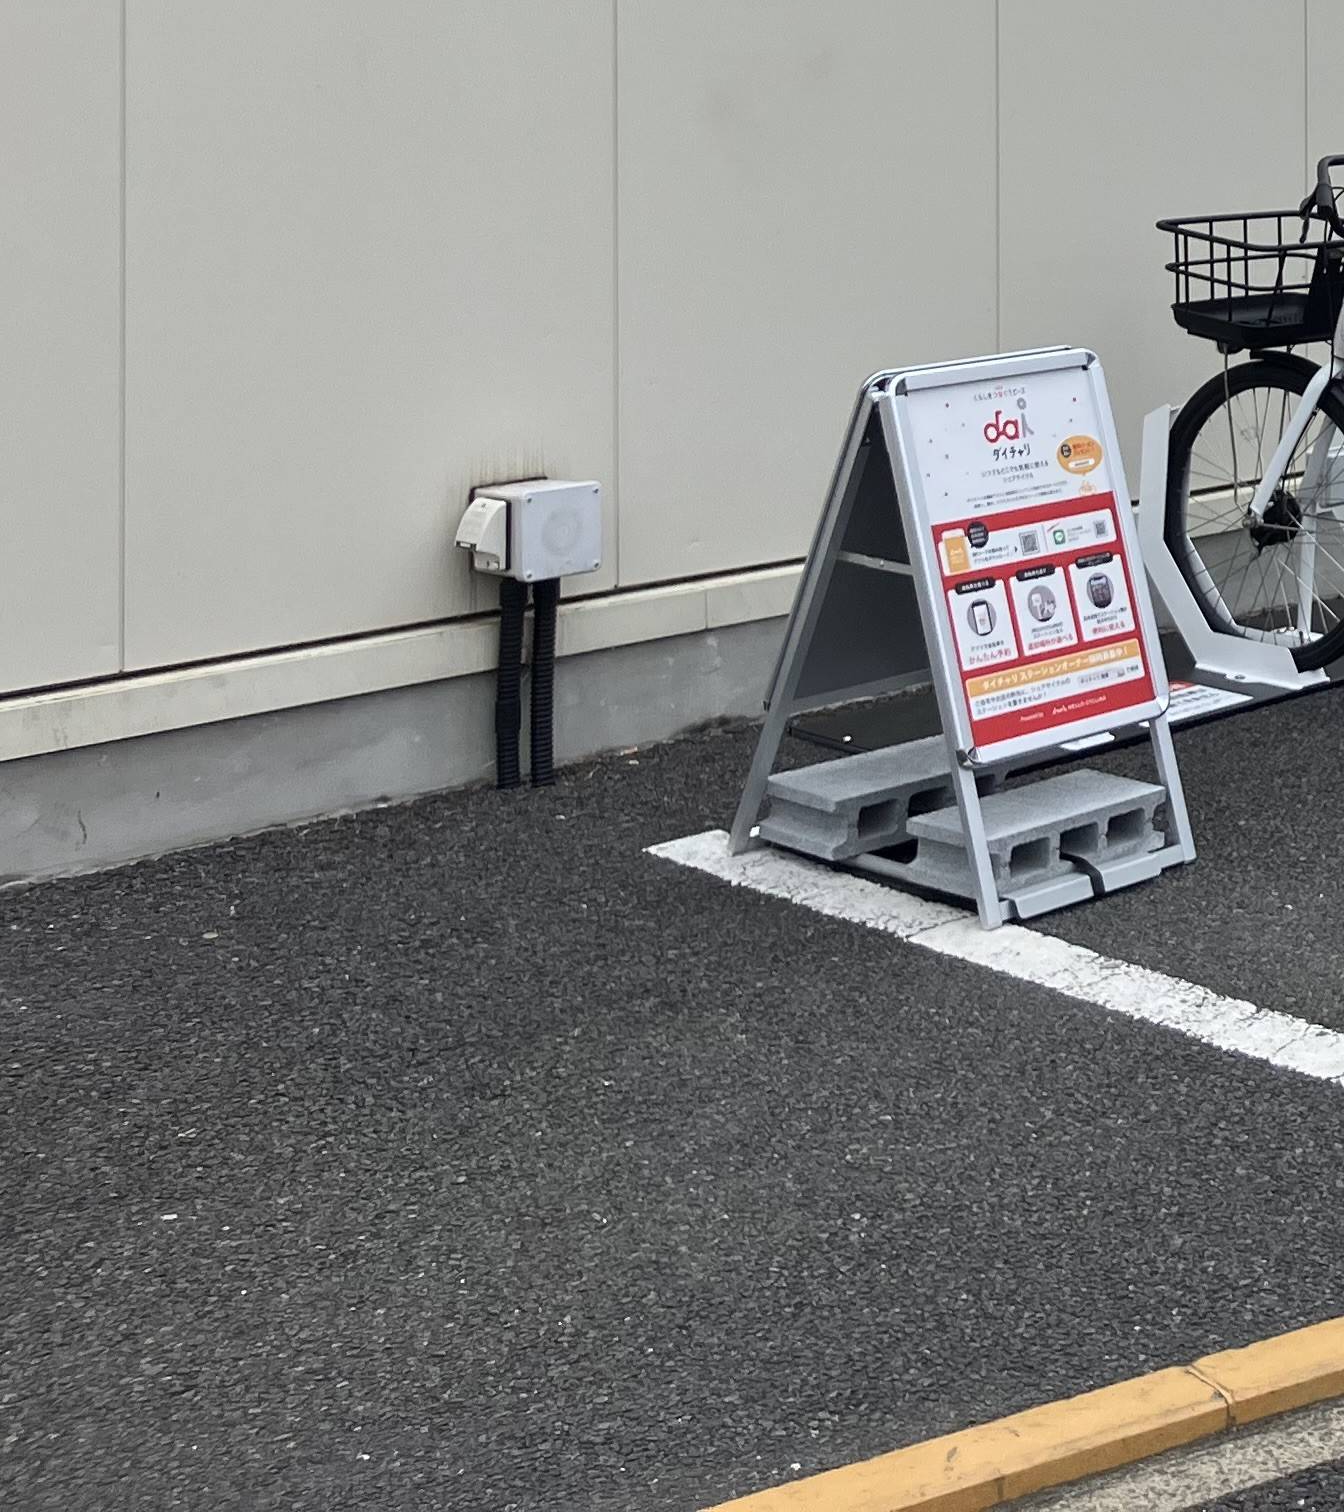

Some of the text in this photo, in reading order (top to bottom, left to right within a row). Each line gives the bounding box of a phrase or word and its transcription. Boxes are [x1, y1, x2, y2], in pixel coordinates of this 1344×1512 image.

[992, 443, 1031, 462] ダイチャリ
